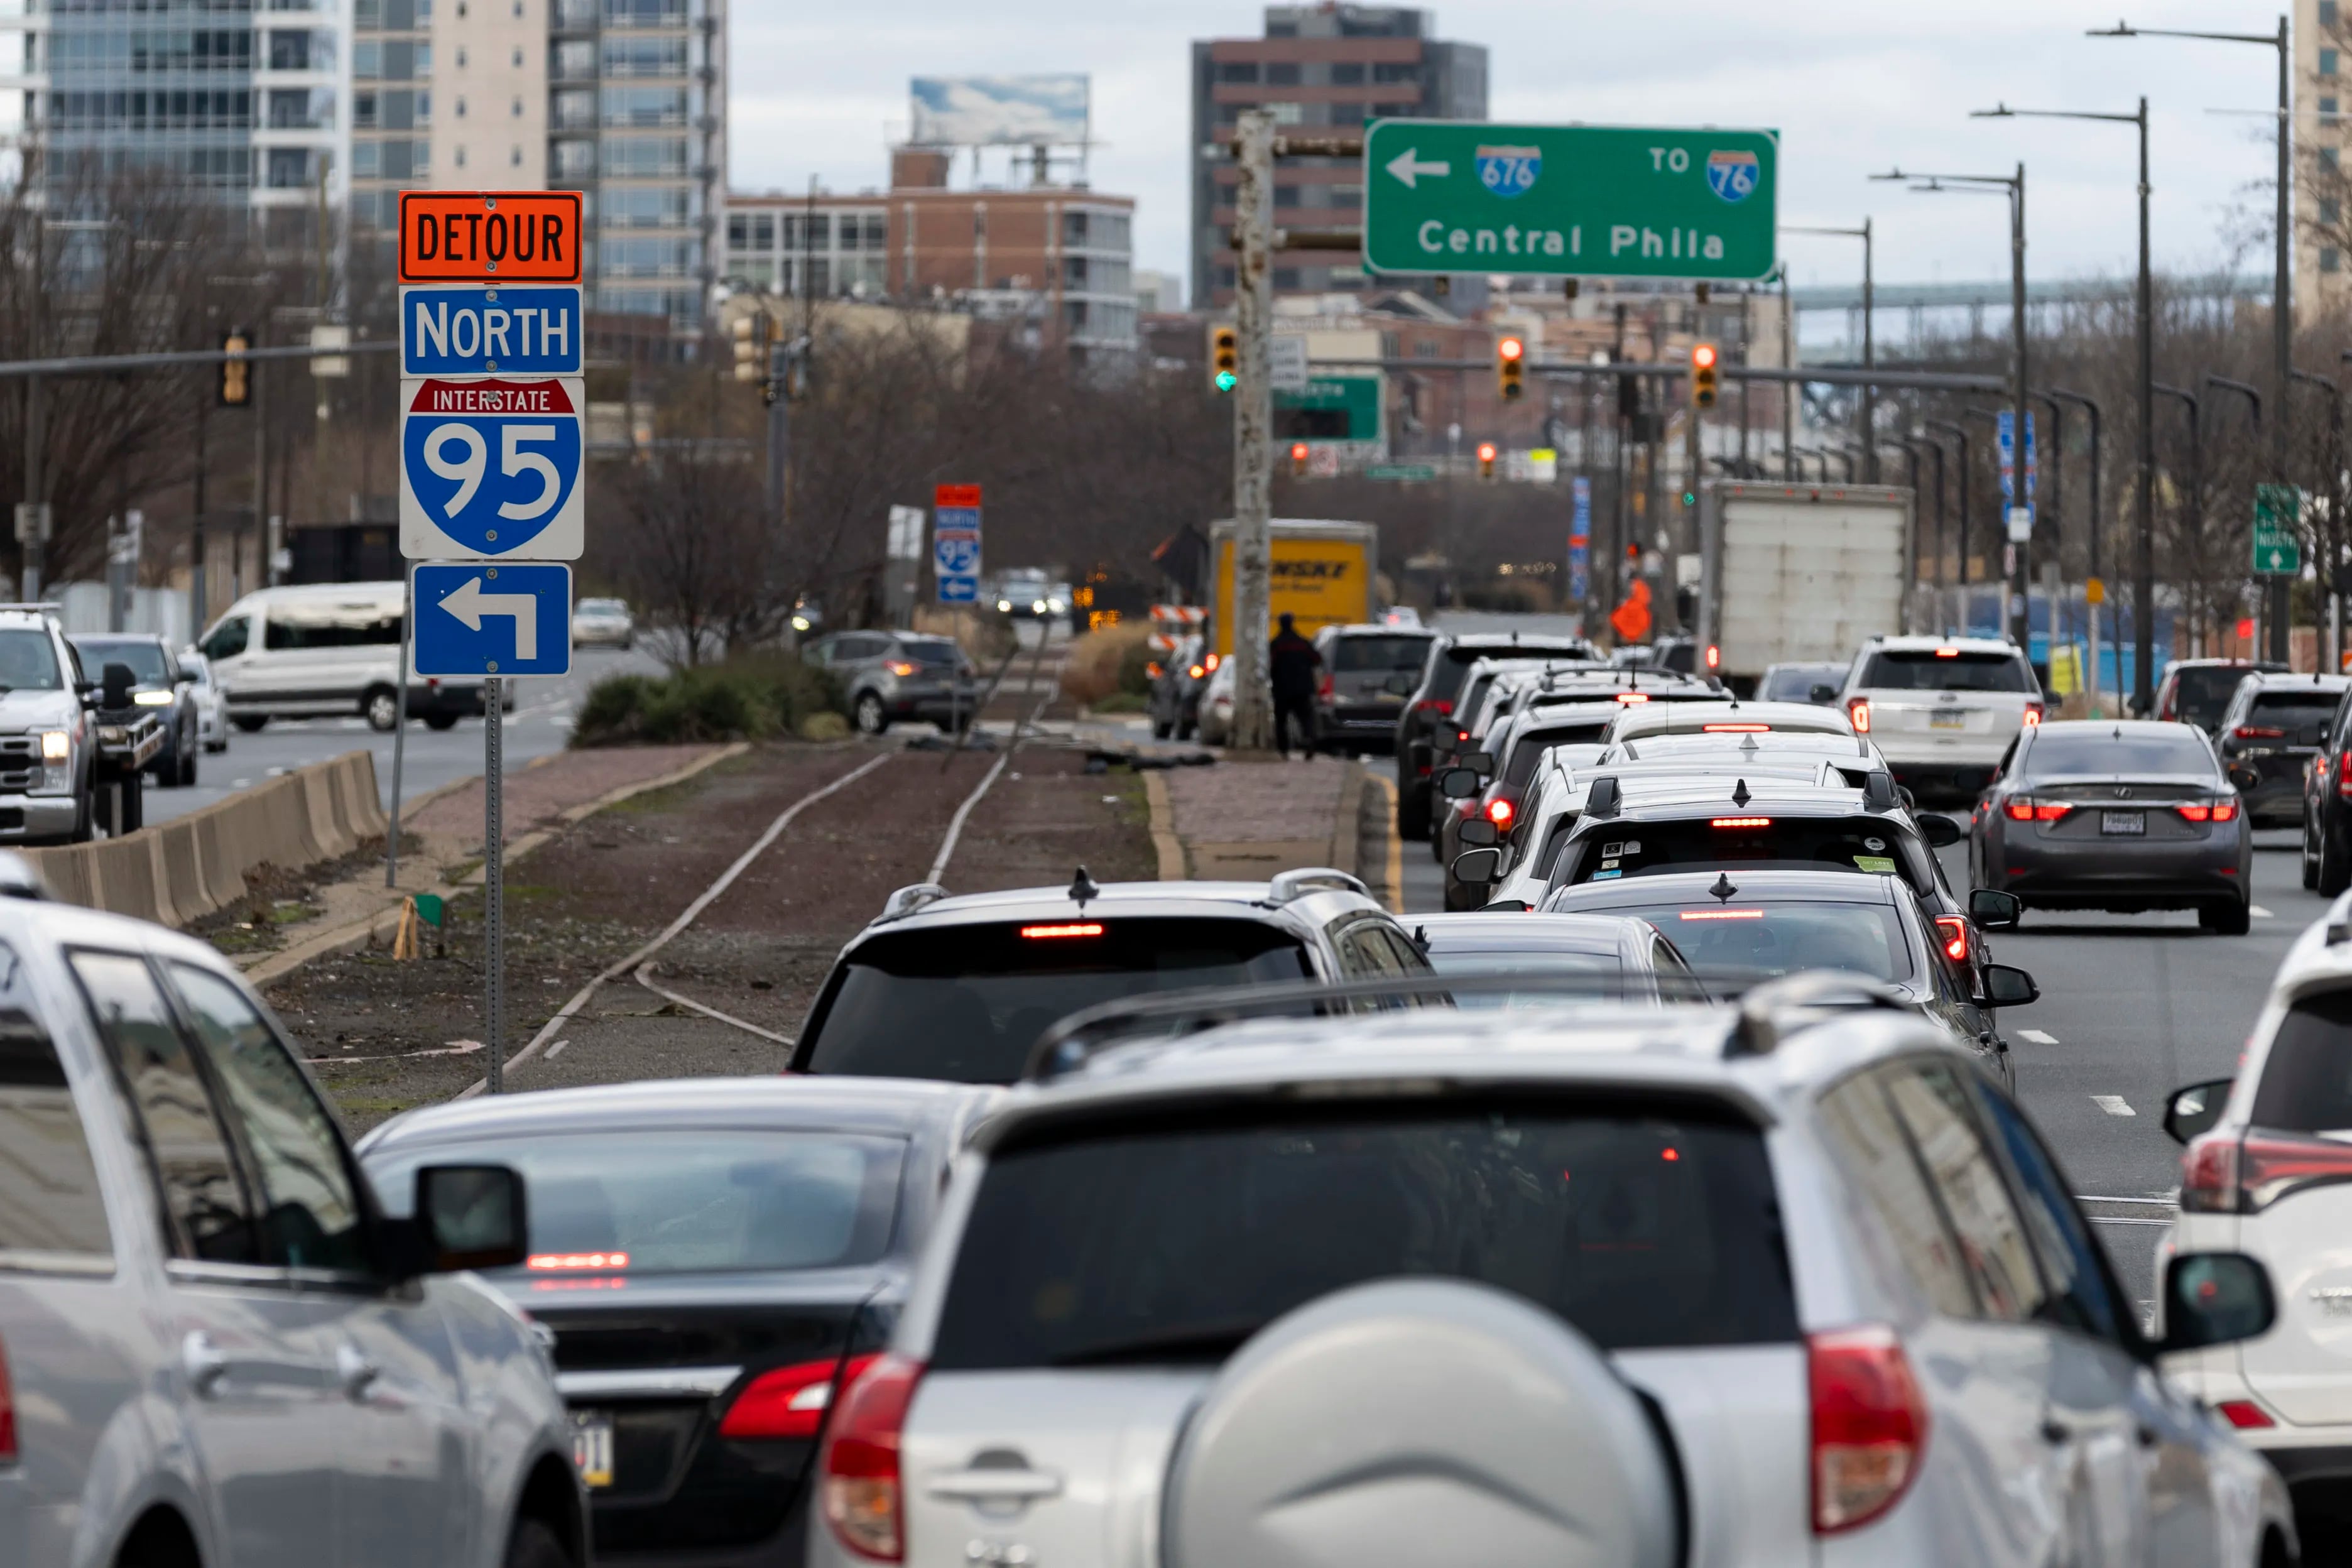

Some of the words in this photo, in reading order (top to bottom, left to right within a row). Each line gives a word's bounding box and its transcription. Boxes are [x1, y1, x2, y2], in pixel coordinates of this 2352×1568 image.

[1481, 156, 1535, 189] 676
[1649, 147, 1690, 173] TO
[1714, 163, 1755, 196] 76
[418, 214, 564, 261] DETOUR
[1418, 220, 1581, 255] Central
[1611, 225, 1724, 259] Phila
[416, 302, 569, 357] NORTH
[433, 390, 550, 411] INTERSTATE
[423, 422, 561, 521] 95
[940, 541, 974, 567] 95
